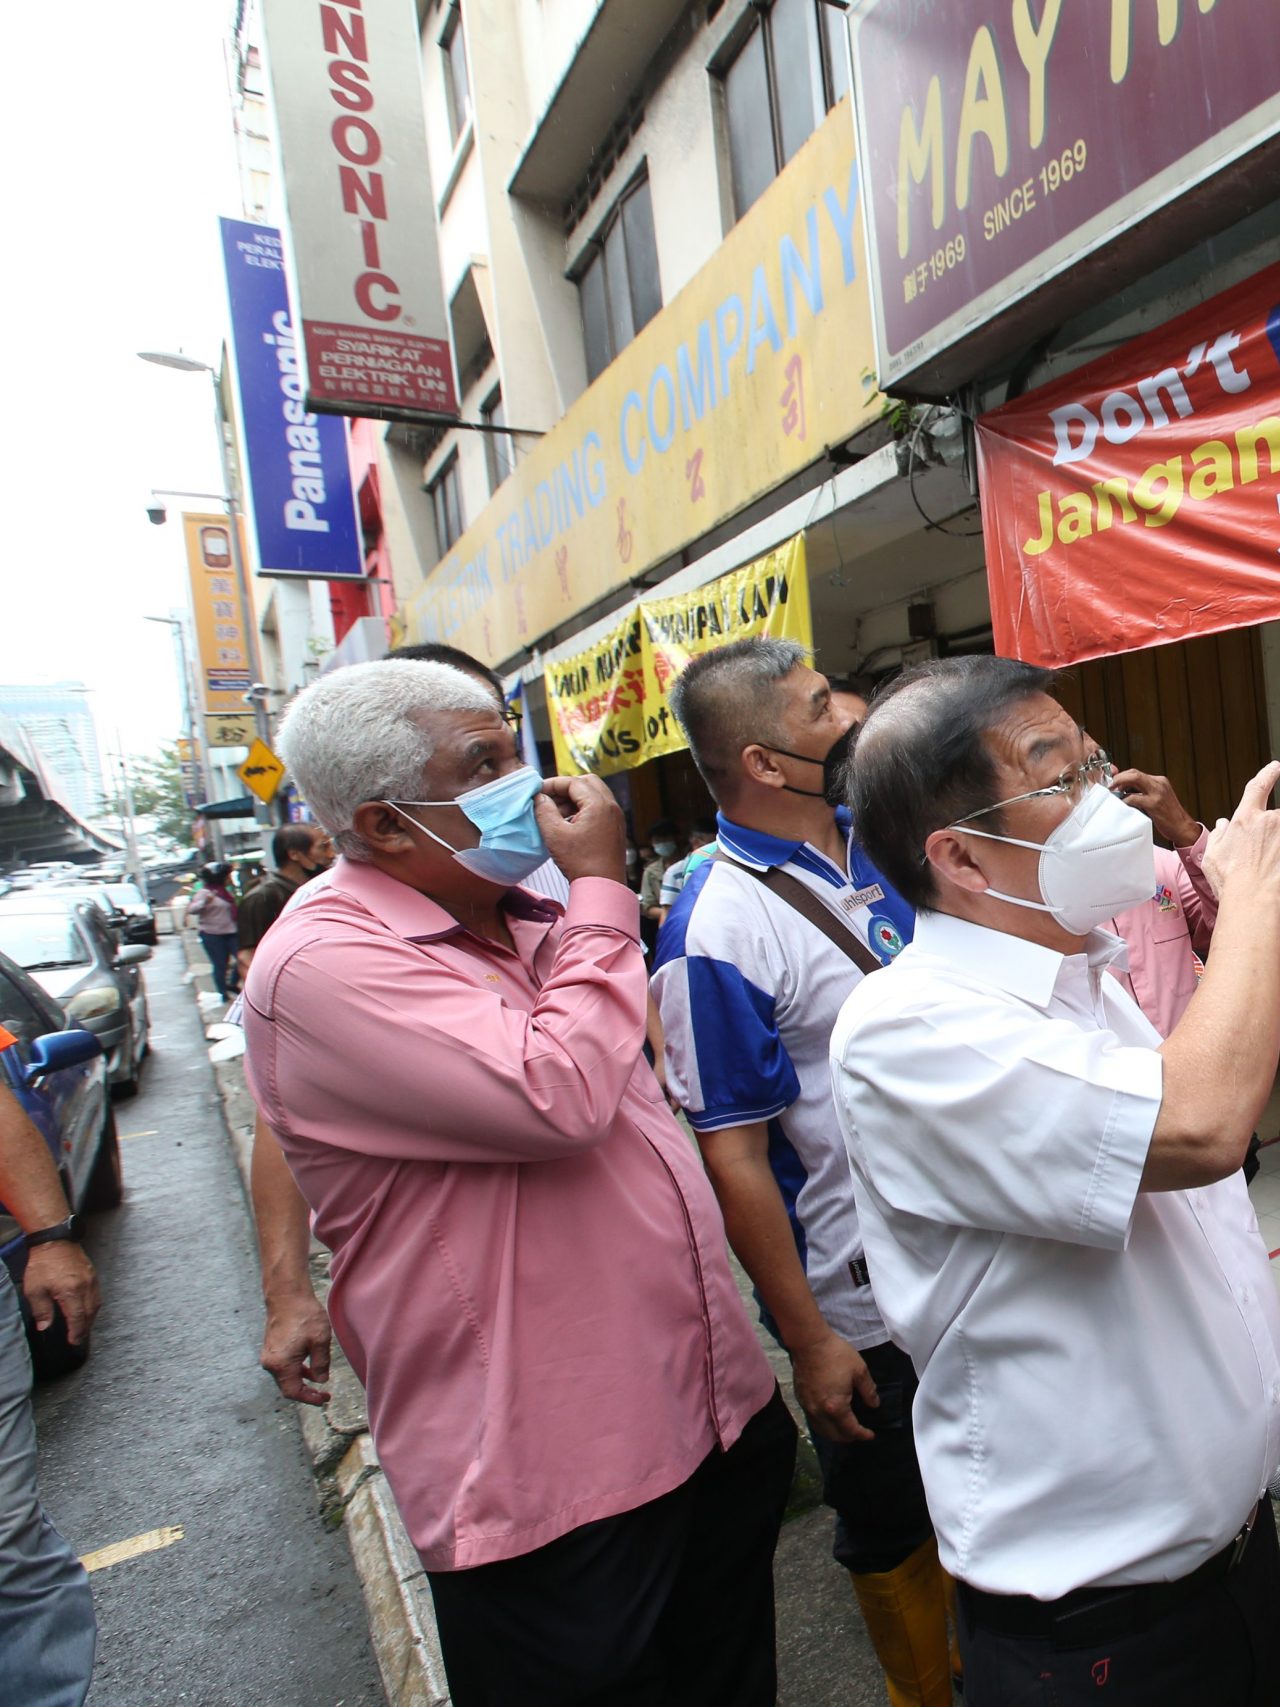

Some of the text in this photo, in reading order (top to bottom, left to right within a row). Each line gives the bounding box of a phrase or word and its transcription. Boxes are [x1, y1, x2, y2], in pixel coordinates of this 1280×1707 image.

[319, 0, 402, 322] NSONIC
[897, 0, 1061, 259] MAY
[983, 138, 1087, 240] SINCE 1969
[318, 364, 448, 393] ELEKTRIK UNI
[320, 351, 442, 378] PERNIAGAAN
[336, 339, 423, 362] SYARIKAT
[495, 432, 607, 583] TRADING
[620, 157, 859, 477] COMPANY
[1048, 325, 1251, 467] Don't
[264, 310, 330, 532] Panasonic
[842, 885, 882, 911] uhlsport
